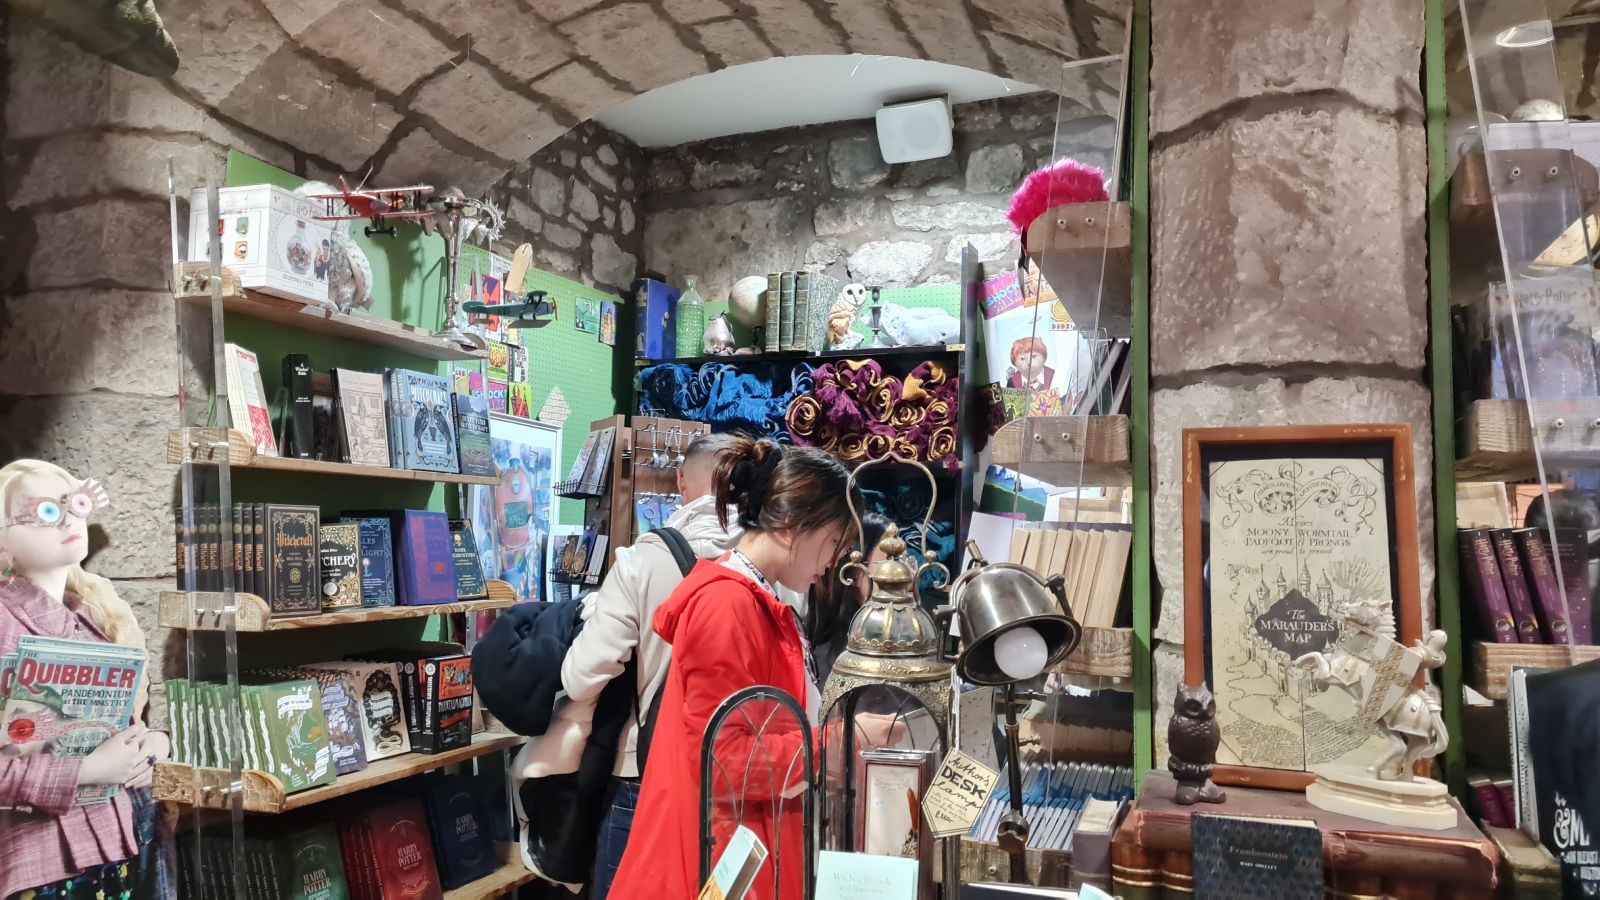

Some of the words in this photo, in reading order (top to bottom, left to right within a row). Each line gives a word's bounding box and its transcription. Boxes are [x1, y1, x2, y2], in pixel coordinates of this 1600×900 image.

[986, 281, 1020, 306] SHOCK
[410, 386, 447, 403] WITCHCRAFT
[1247, 527, 1289, 537] MOONY
[276, 533, 314, 547] Witchcraft
[1245, 537, 1293, 547] PADFOOT
[1309, 537, 1351, 547] PRONGS
[322, 553, 356, 567] CHERY
[1287, 609, 1306, 620] The
[1260, 619, 1335, 632] MARAUDER'S
[1284, 632, 1312, 644] MAP
[23, 651, 39, 659] THE
[17, 657, 137, 695] QUIBBLER
[61, 688, 132, 699] PANDEMONIUM
[948, 756, 991, 787] Author's
[941, 764, 987, 801] DESK
[455, 813, 474, 826] HARRY
[456, 822, 478, 834] POTTER
[397, 843, 418, 858] HARRY
[1229, 845, 1288, 861] Frankenstein
[398, 851, 422, 868] POTTER
[303, 867, 327, 884] HARRY
[303, 877, 331, 896] POTTER
